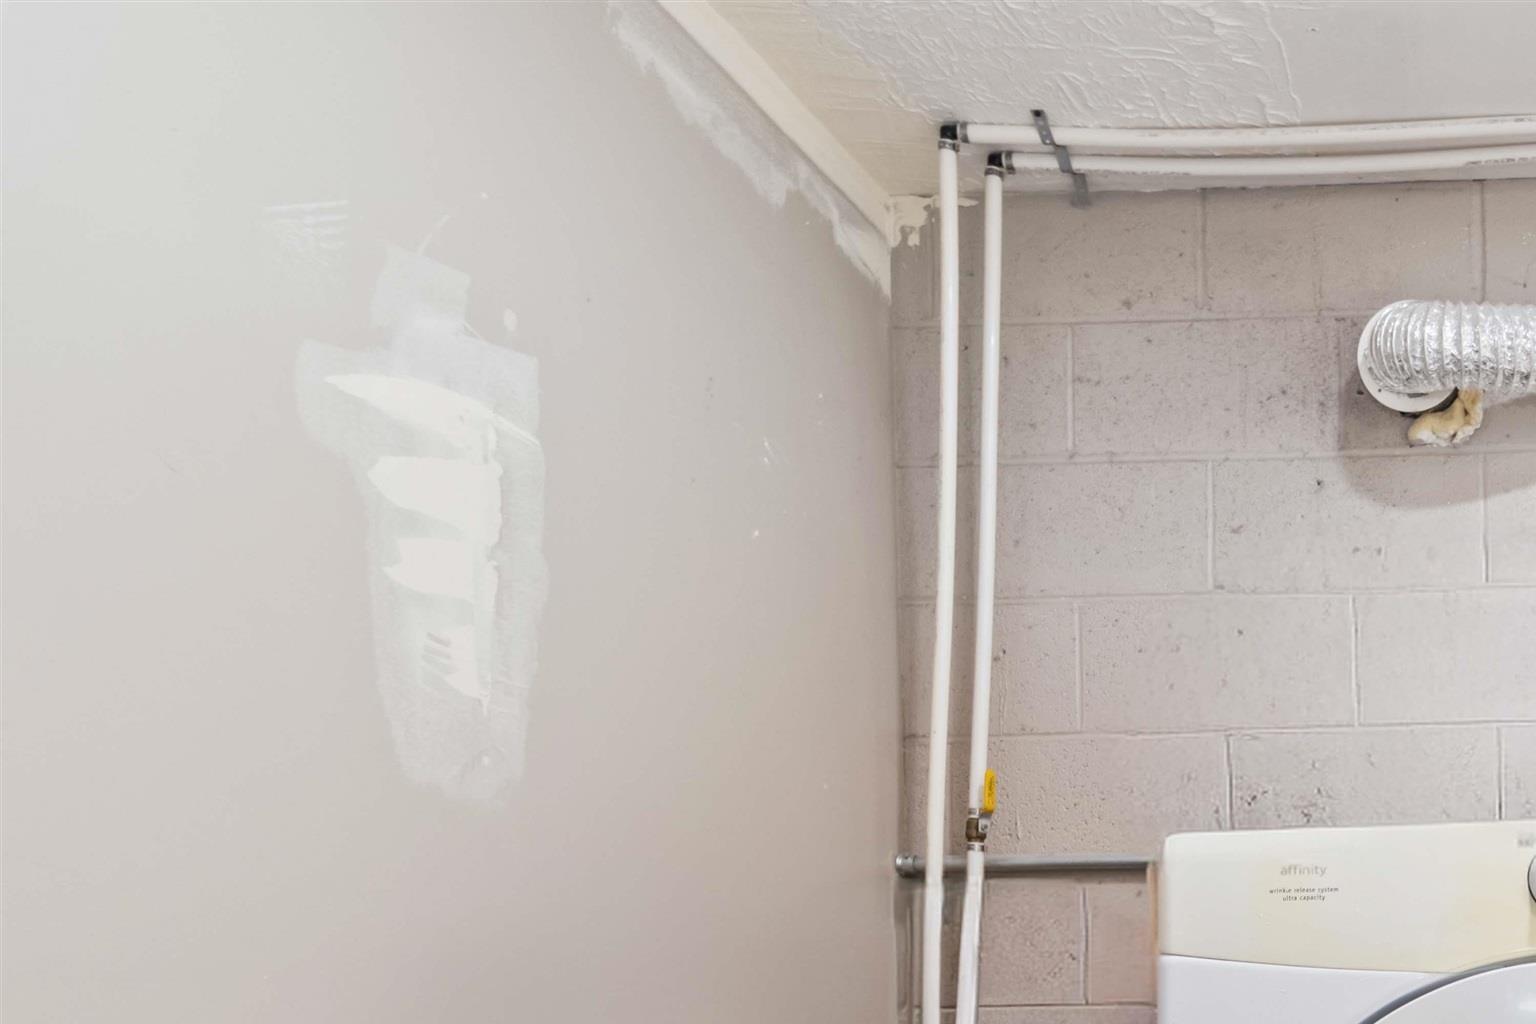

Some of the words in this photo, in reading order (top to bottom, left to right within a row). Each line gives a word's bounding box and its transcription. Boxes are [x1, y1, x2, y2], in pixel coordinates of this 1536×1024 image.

[1280, 863, 1328, 877] affinity
[1318, 886, 1339, 894] system
[1299, 894, 1326, 902] capacity
